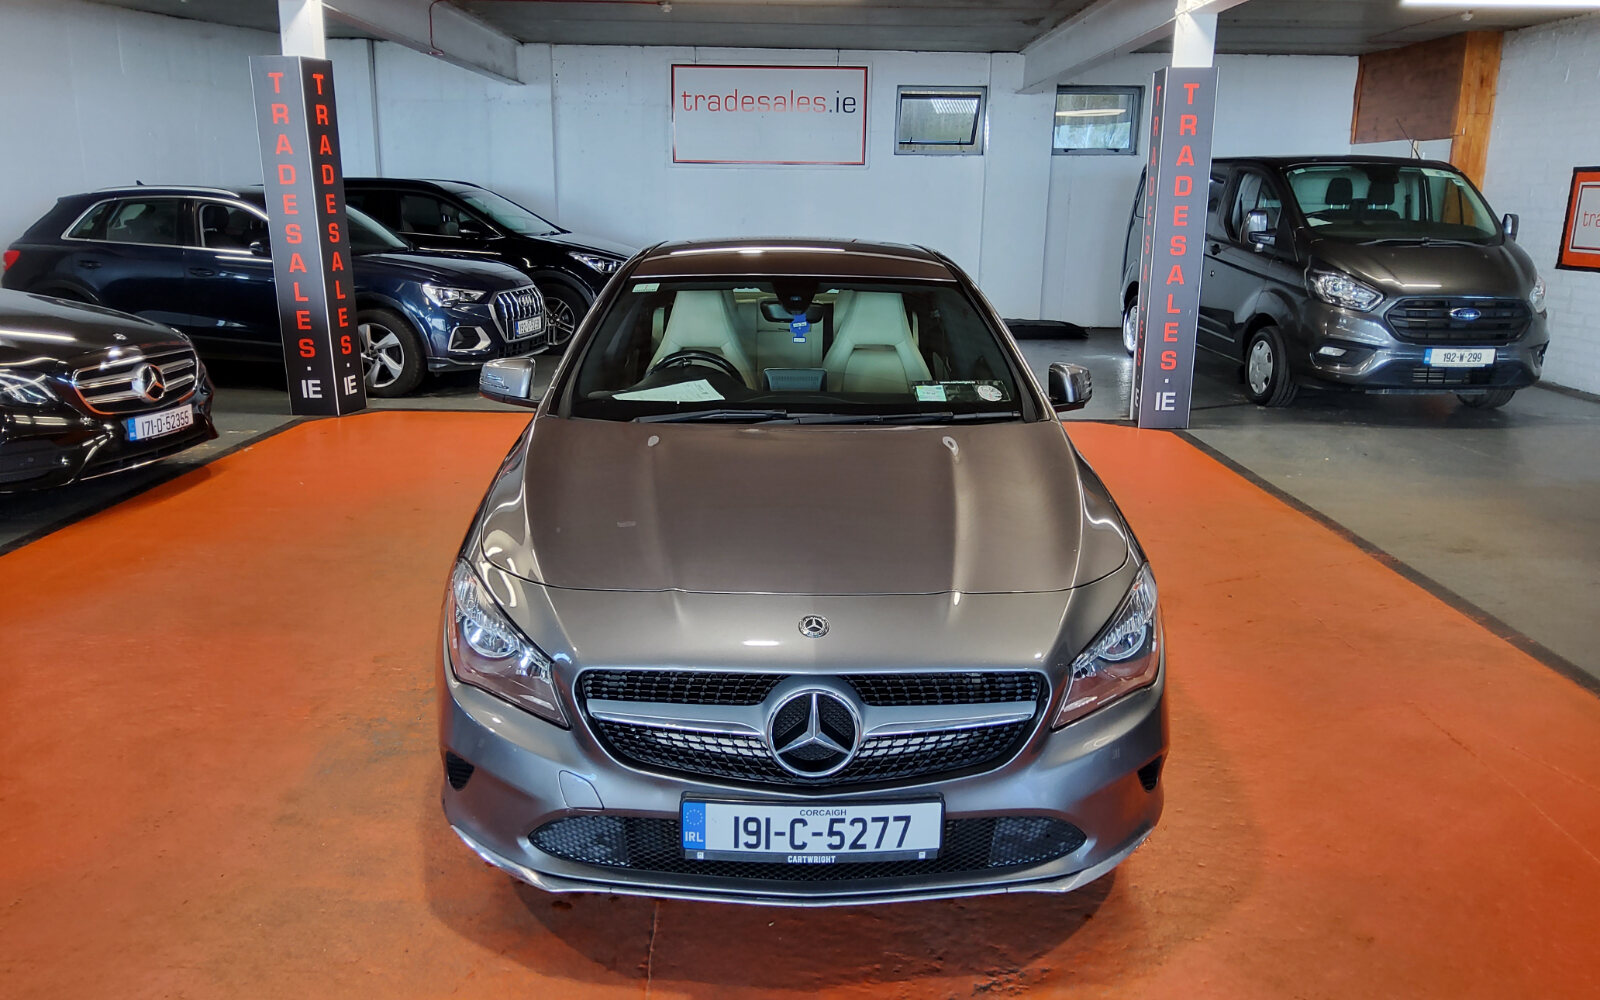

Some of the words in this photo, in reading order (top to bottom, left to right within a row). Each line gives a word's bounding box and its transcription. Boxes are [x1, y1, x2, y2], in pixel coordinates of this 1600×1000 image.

[681, 88, 857, 114] tradesales.ie
[1443, 352, 1483, 363] 192-W-299
[141, 410, 189, 437] 171-D-52355
[799, 809, 847, 817] CORCAIGH
[684, 831, 704, 843] IRL
[733, 815, 912, 851] 191-C-5277
[787, 855, 837, 864] CARTWRIGHT
